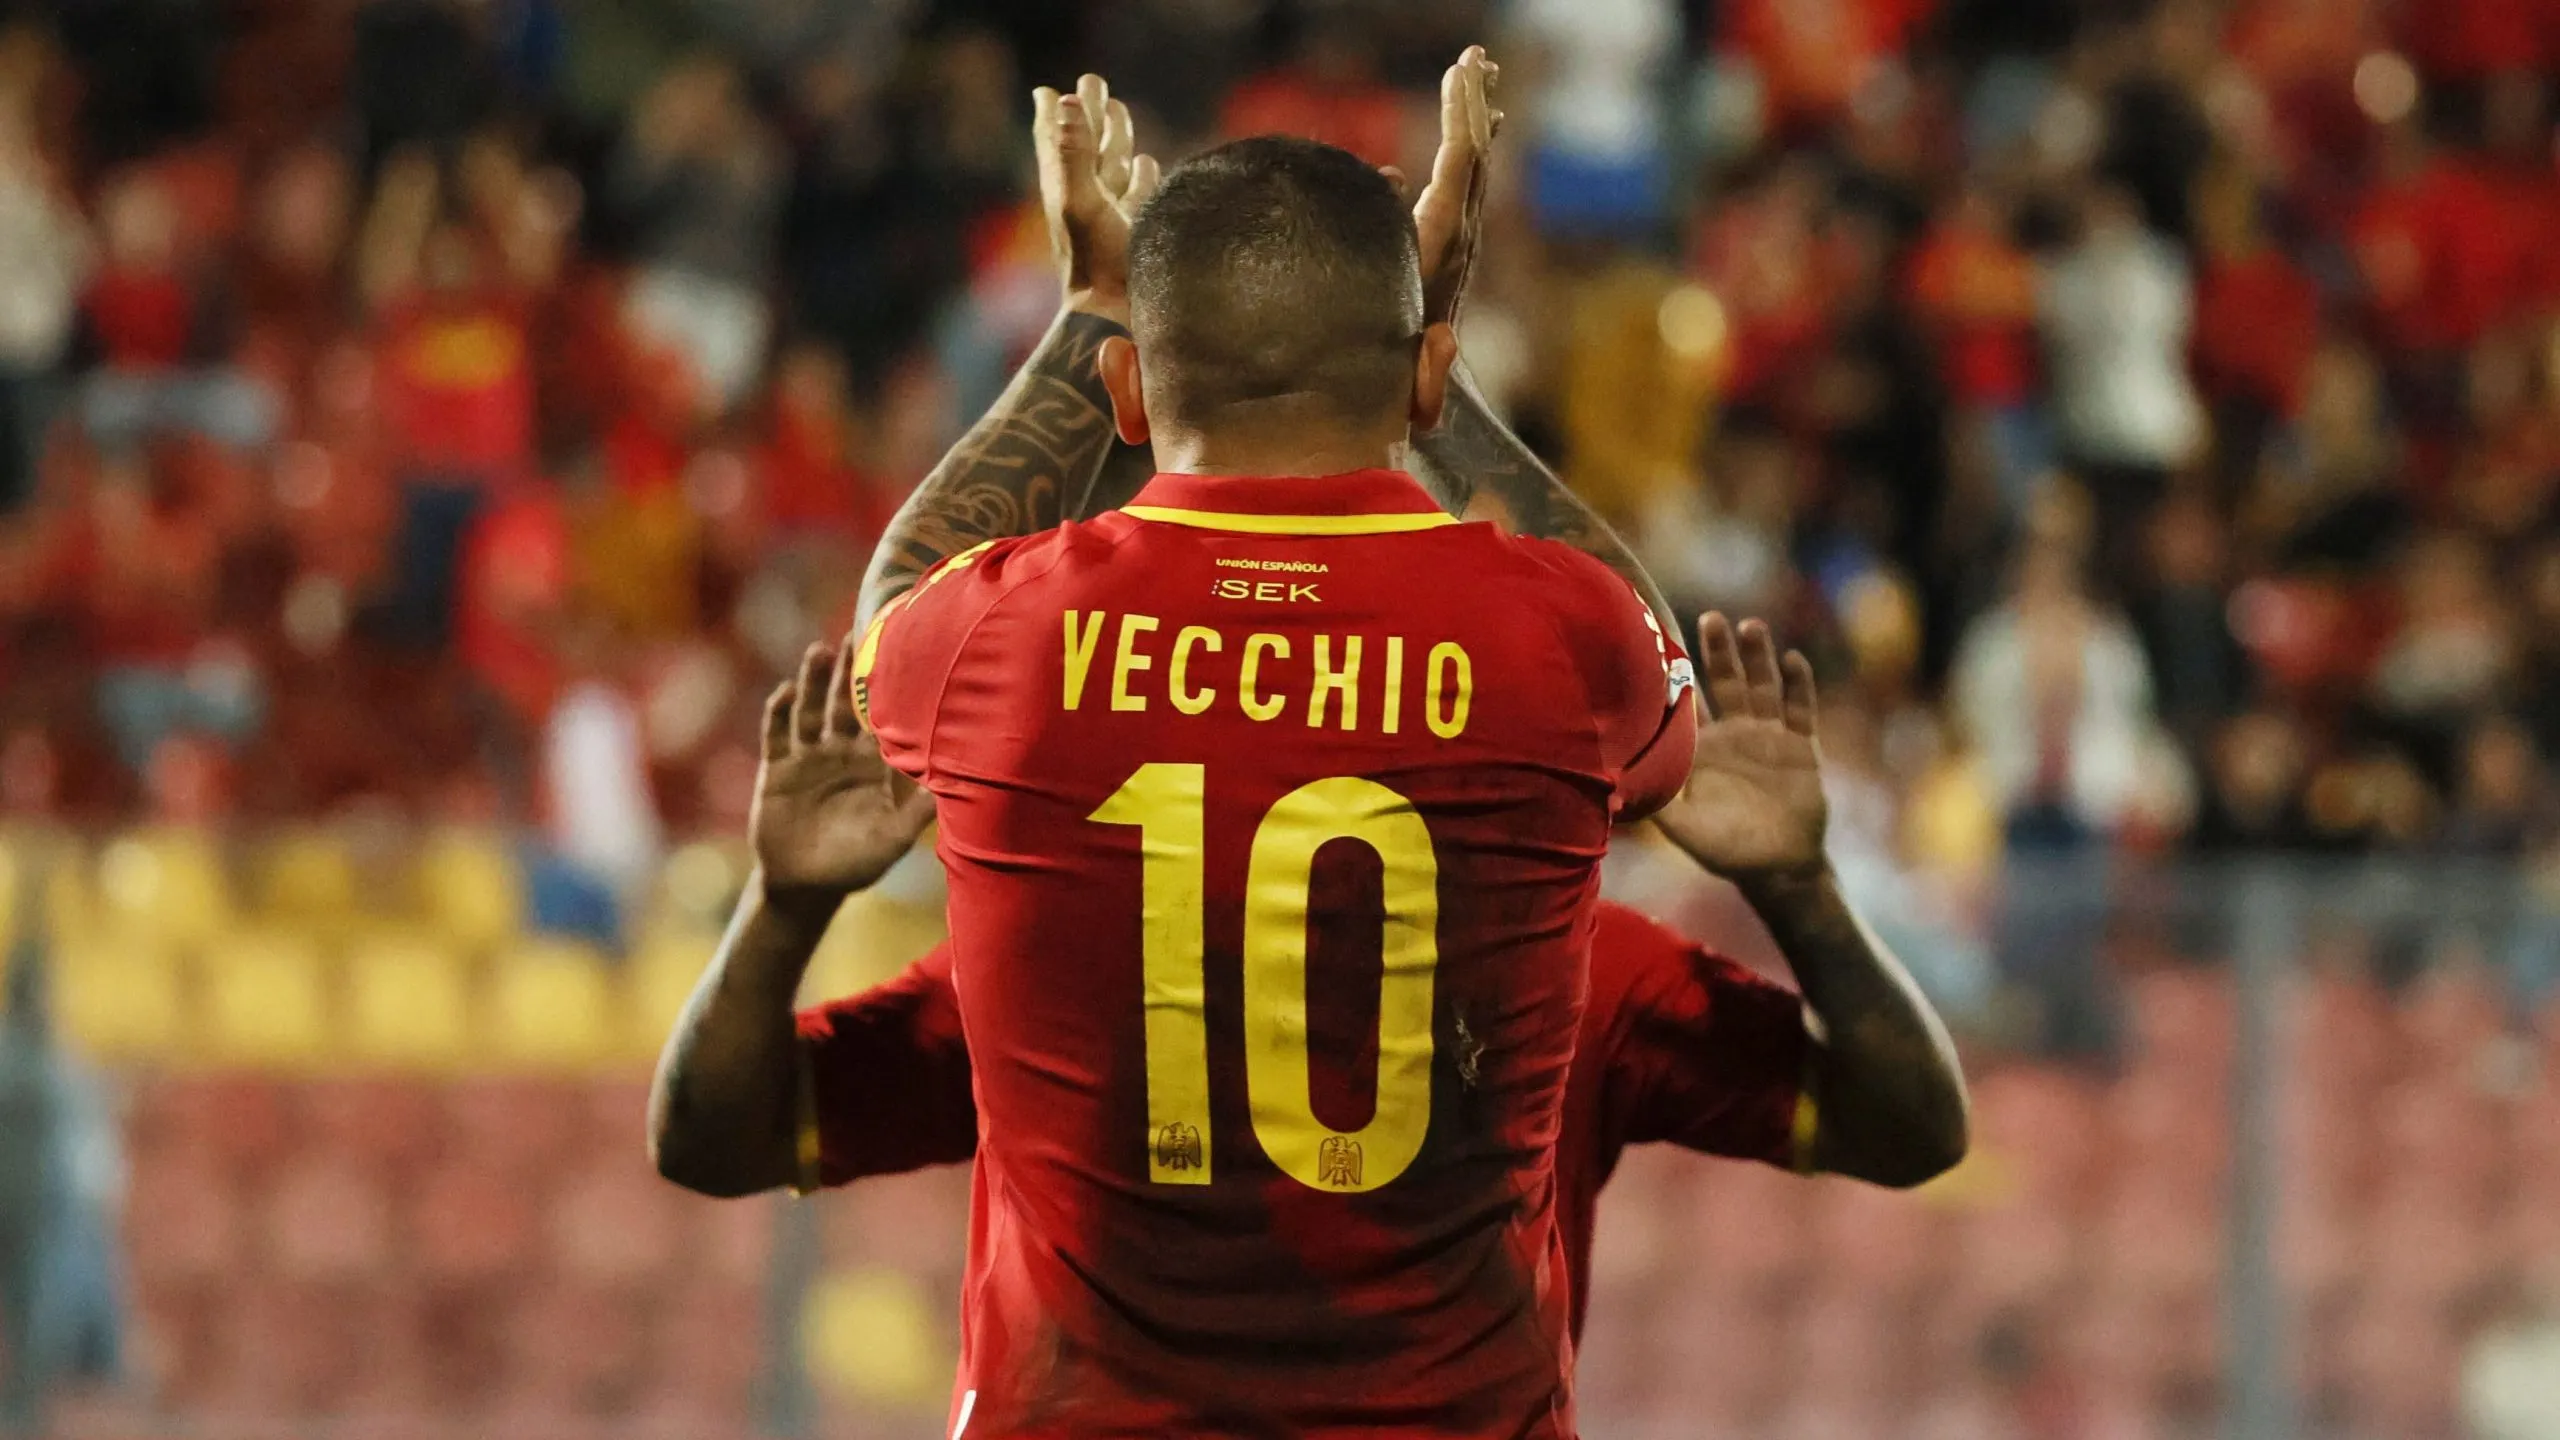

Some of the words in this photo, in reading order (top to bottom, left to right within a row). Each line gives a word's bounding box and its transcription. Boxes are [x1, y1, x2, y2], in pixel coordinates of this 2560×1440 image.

[1216, 558, 1260, 570] UNIÓN
[1261, 560, 1329, 573] ESPAÑOLA
[1218, 579, 1322, 603] SEK
[1063, 610, 1473, 739] VECCHIO
[1086, 762, 1439, 1193] 10
